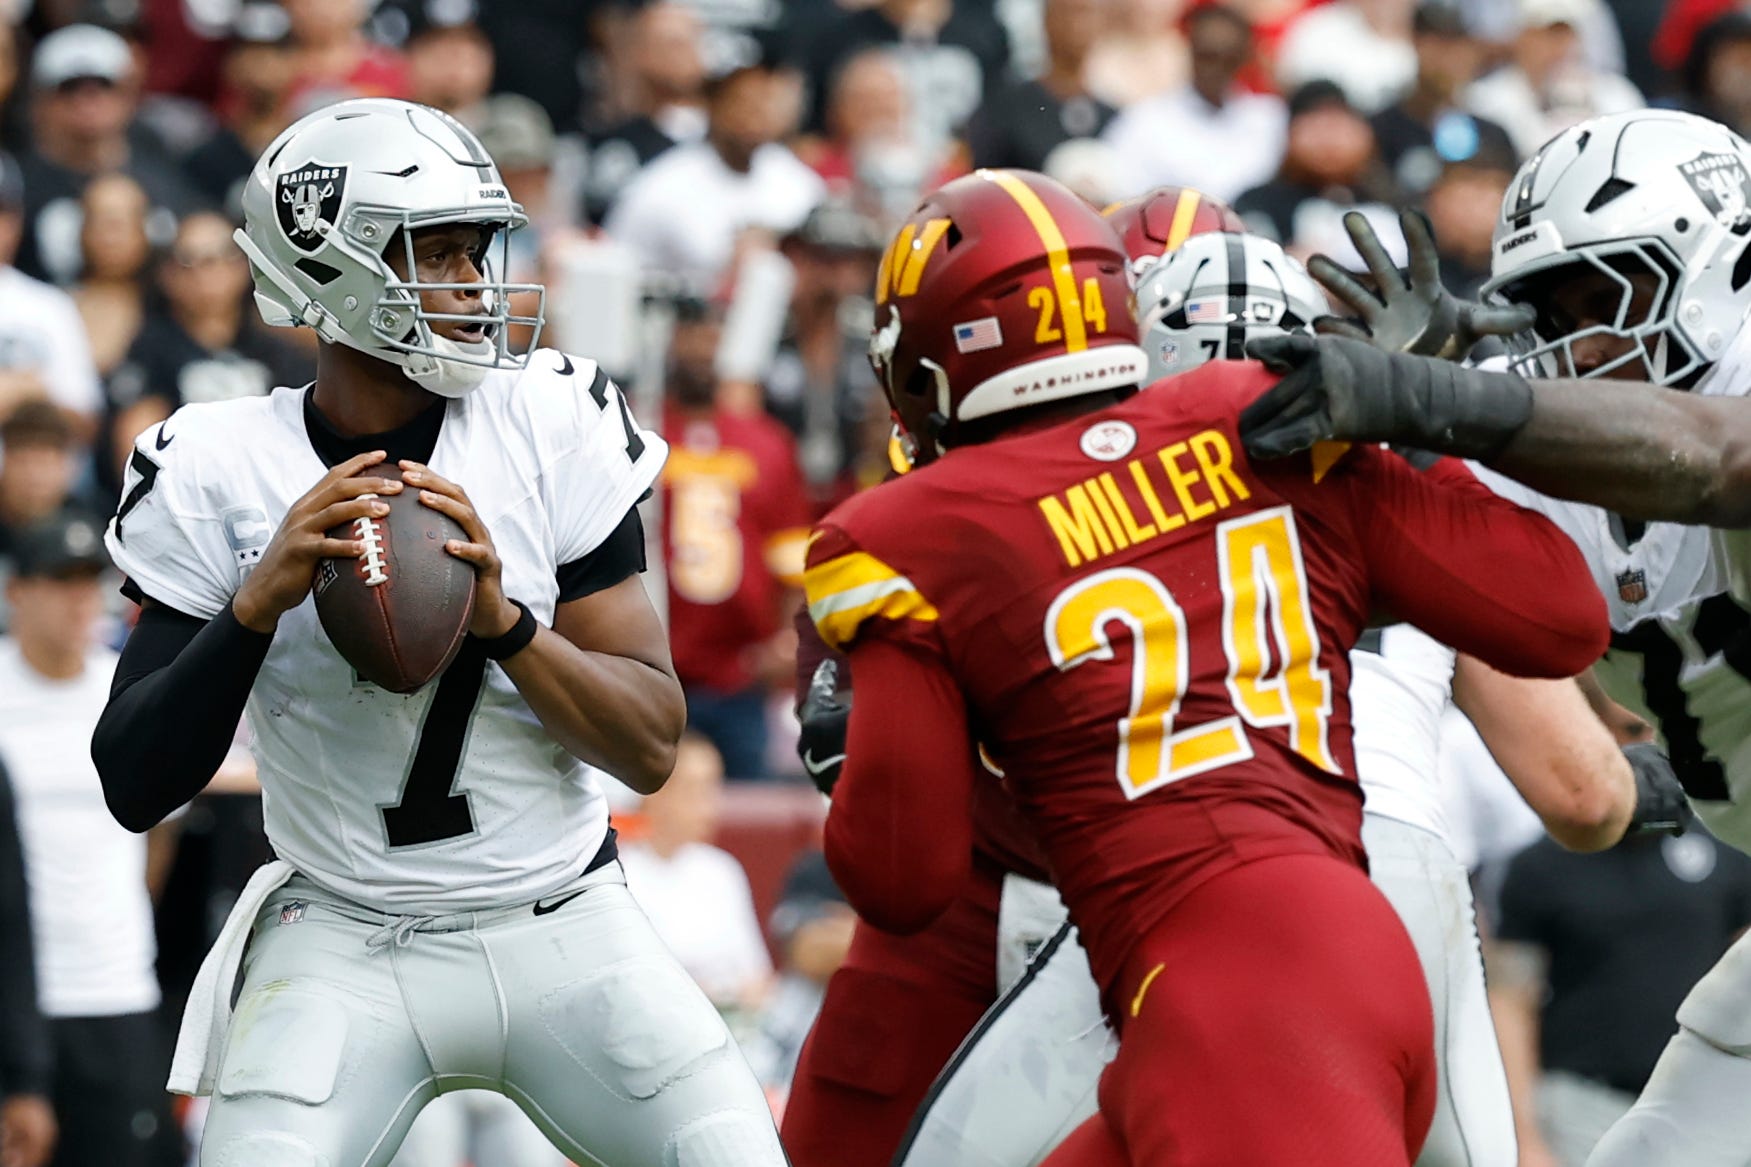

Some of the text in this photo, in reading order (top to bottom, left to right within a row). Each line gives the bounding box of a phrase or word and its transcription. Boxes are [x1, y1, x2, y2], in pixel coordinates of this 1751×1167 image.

[281, 168, 340, 186] RAIDERS
[1028, 277, 1106, 343] 24
[1014, 364, 1135, 394] WASHINGTON
[1038, 430, 1250, 567] MILLER
[224, 507, 270, 550] C
[1044, 504, 1343, 800] 24
